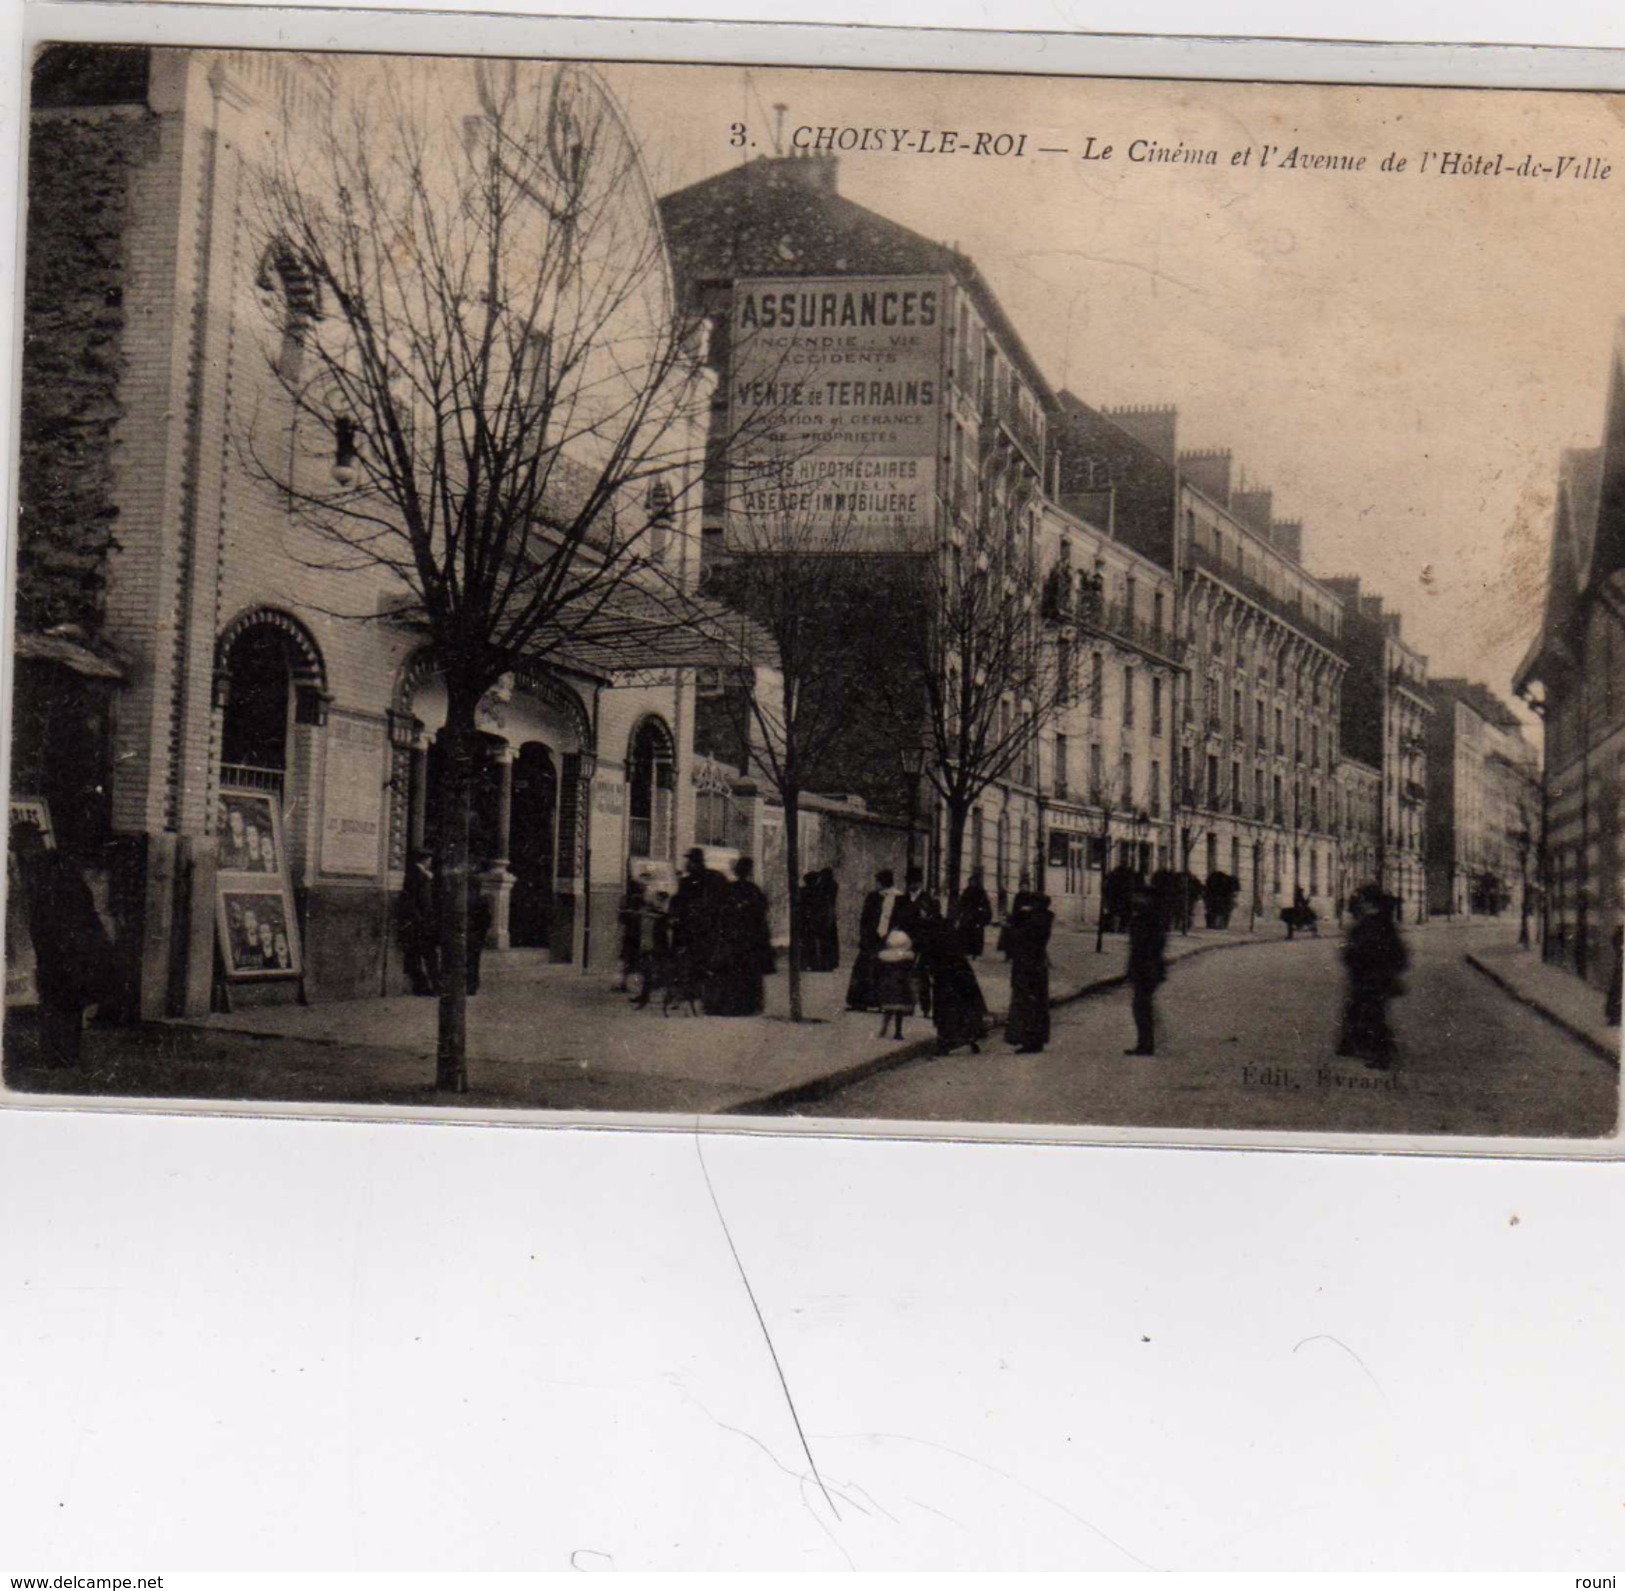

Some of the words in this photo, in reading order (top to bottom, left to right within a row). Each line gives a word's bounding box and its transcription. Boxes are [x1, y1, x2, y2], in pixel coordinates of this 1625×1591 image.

[740, 291, 937, 328] ASSURANCES
[753, 336, 858, 347] INCENDIE
[888, 335, 922, 346] VIE
[782, 353, 898, 364] ACCIDENTS
[738, 382, 804, 407] VENTE
[827, 380, 934, 406] TERRAINS
[816, 493, 917, 512] IMMOBILIERE
